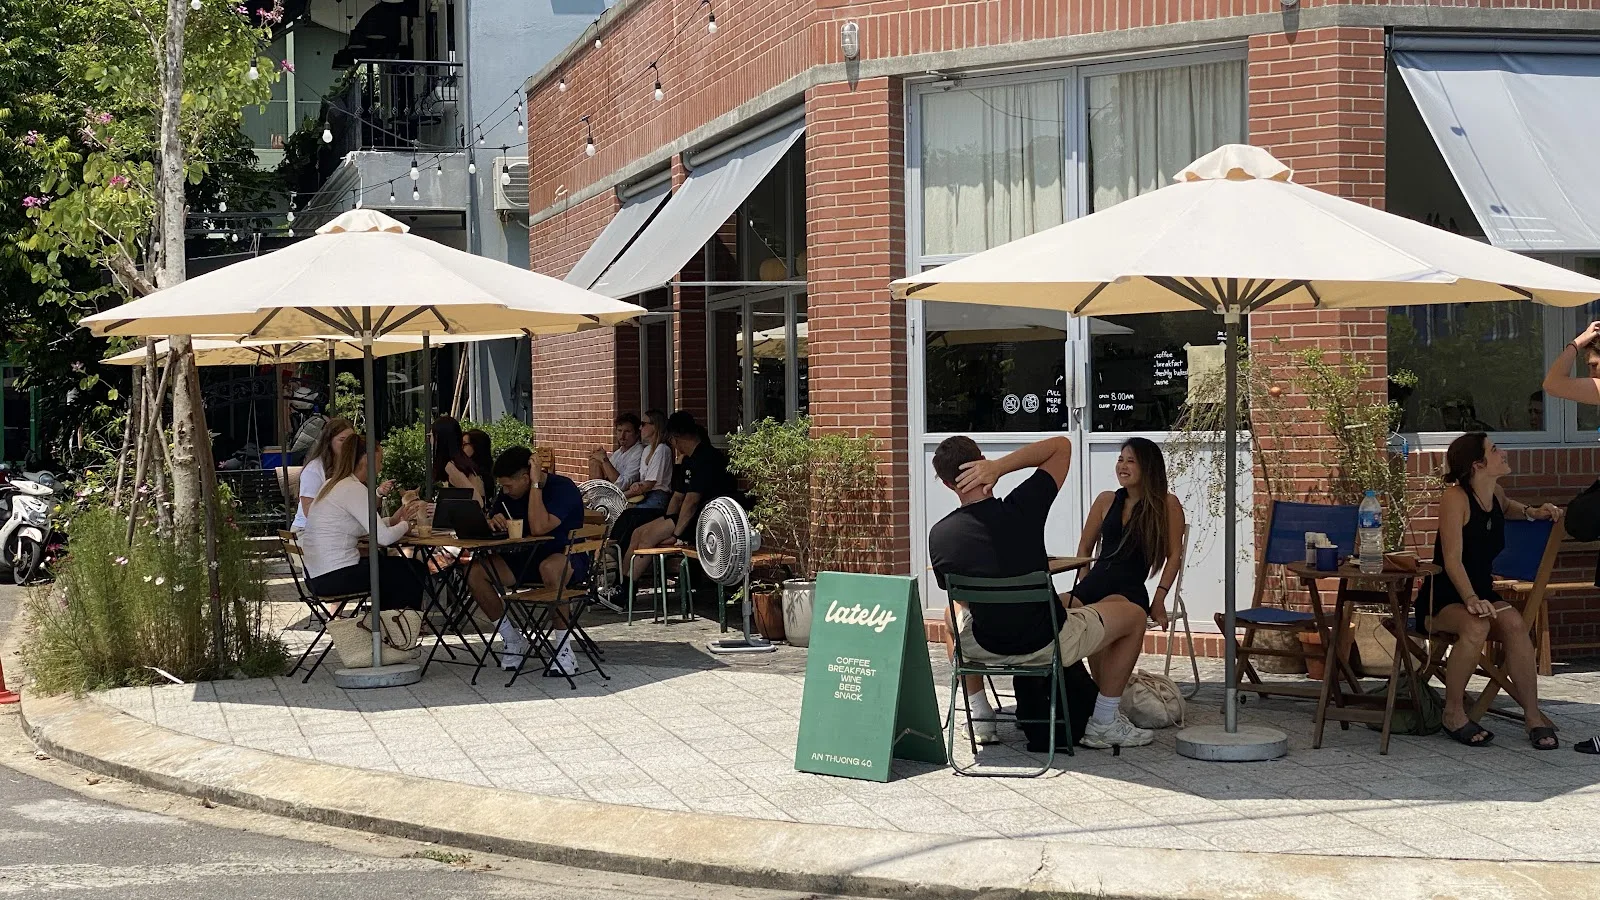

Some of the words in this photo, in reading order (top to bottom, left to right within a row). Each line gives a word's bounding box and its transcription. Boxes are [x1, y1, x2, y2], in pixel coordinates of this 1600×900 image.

[825, 600, 897, 632] lately
[835, 656, 871, 668] COFFEE
[827, 664, 877, 677] BREAKFAST
[840, 674, 862, 684] WINE
[838, 683, 862, 693] BEER
[833, 690, 863, 702] SNACK
[811, 752, 824, 761] AN
[824, 754, 860, 766] THUONG
